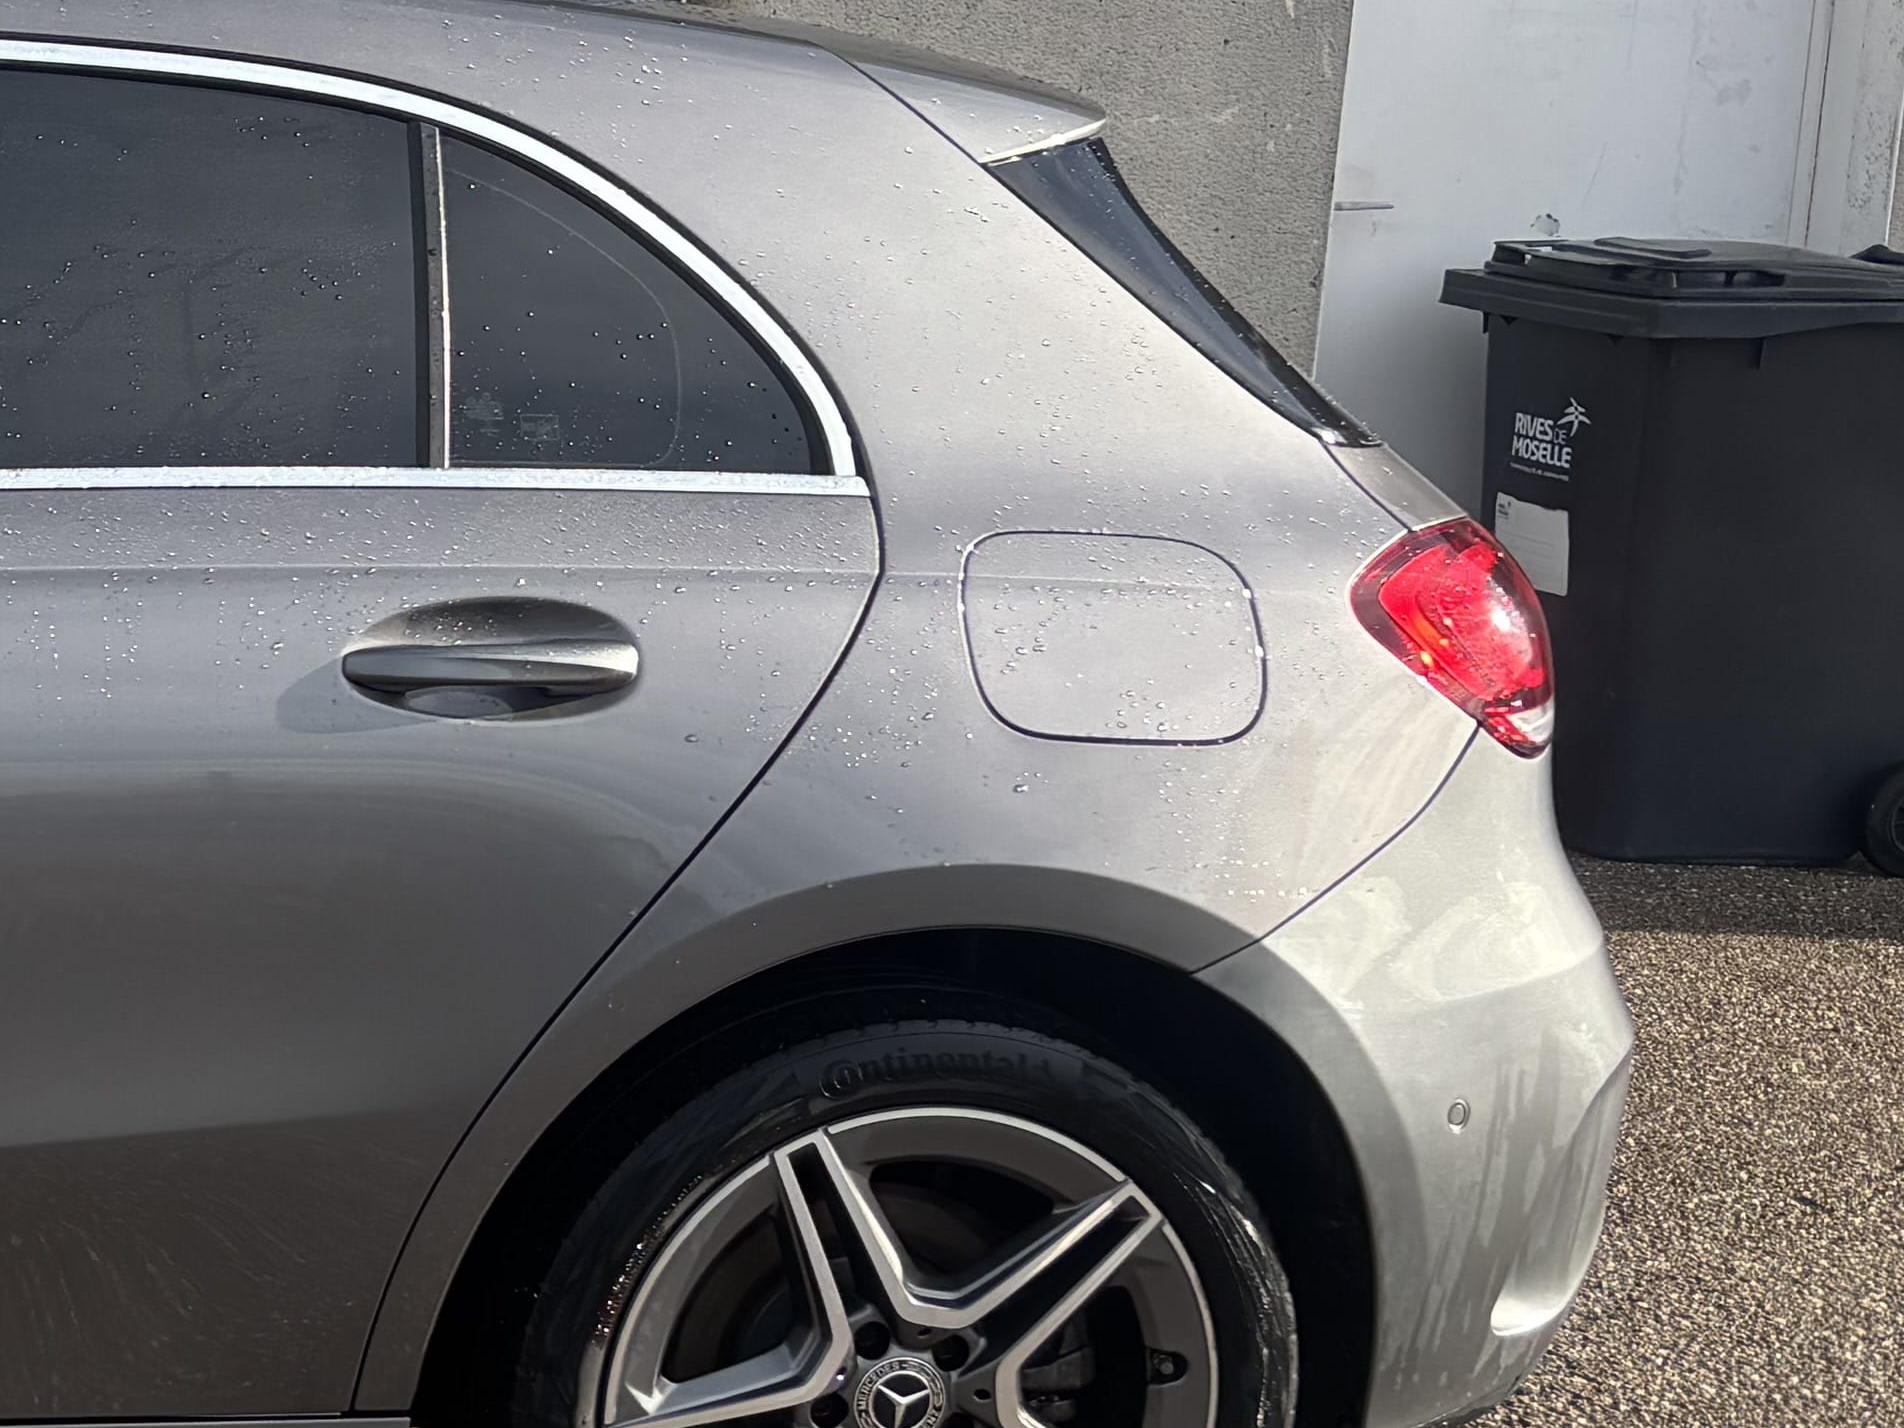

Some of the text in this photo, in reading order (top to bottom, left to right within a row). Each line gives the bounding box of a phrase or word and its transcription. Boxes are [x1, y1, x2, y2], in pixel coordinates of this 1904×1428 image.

[1514, 412, 1568, 444] RIVES DE
[1511, 436, 1572, 468] MOSELLE
